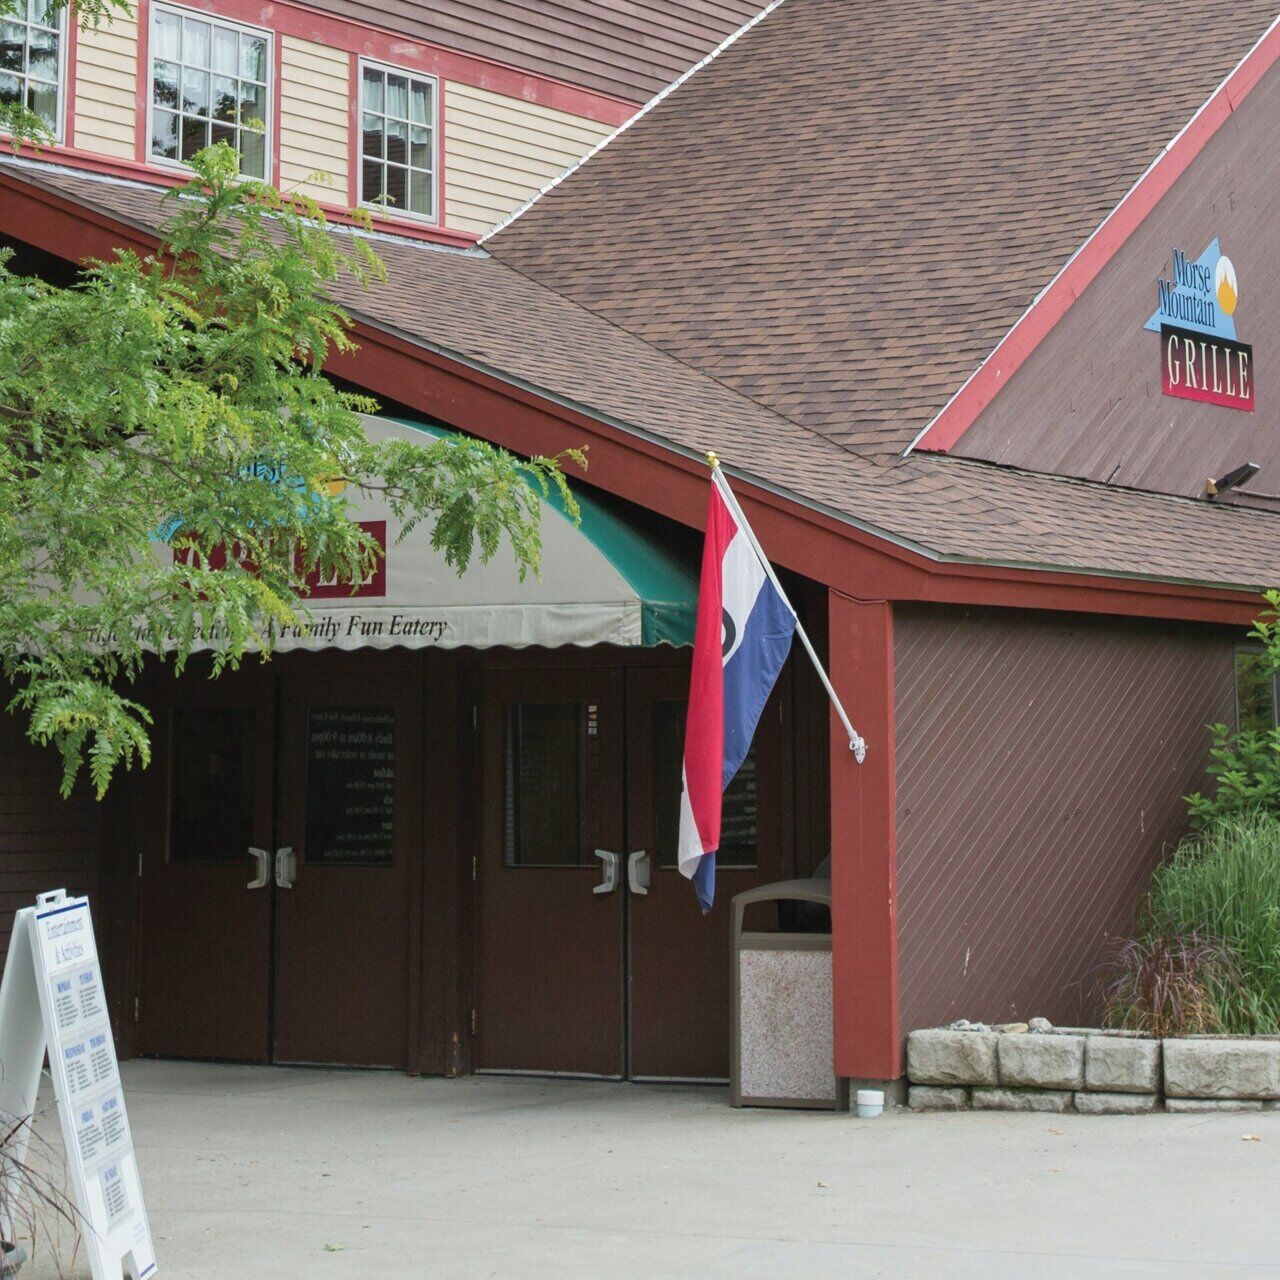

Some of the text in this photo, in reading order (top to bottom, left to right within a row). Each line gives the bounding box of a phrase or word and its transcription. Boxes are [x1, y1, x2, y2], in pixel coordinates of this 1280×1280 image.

[1173, 248, 1211, 293] Morse
[1158, 277, 1216, 328] Mountain
[1167, 334, 1250, 400] GRILLE
[261, 620, 273, 639] A
[346, 615, 384, 637] Fun
[389, 614, 448, 642] Eatery
